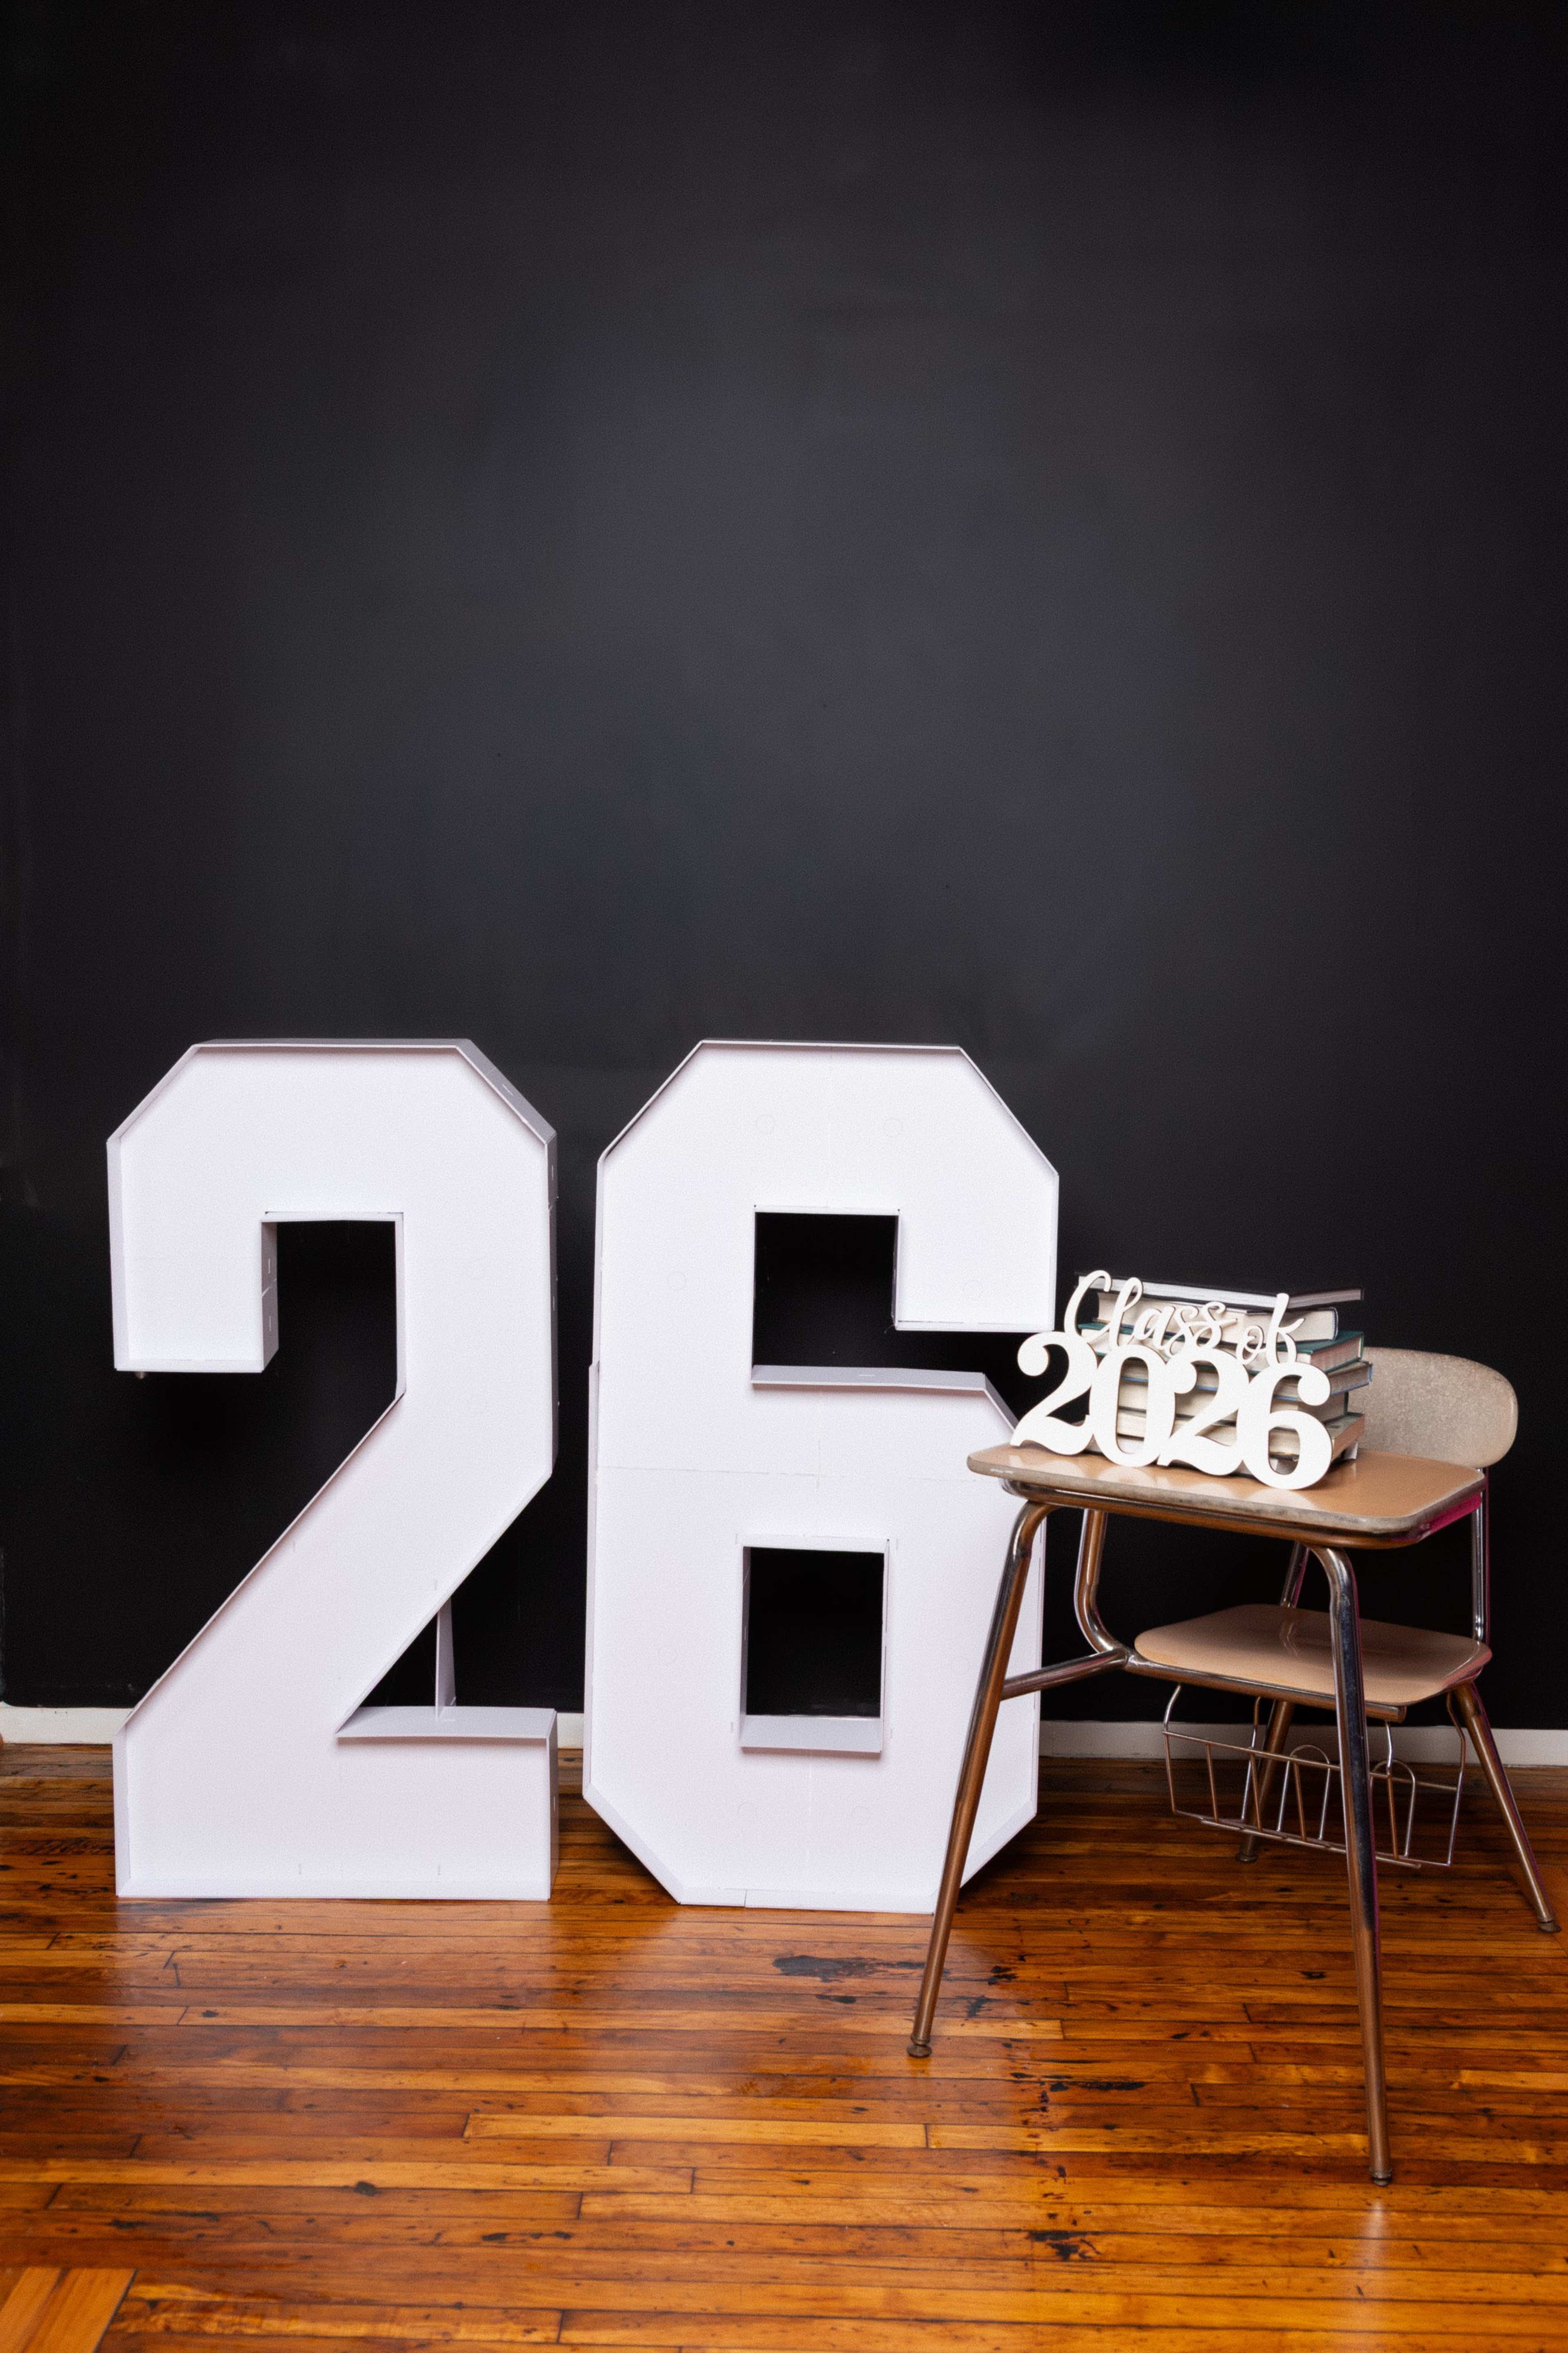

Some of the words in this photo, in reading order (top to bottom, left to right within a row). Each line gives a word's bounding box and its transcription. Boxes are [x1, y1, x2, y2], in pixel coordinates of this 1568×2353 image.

[1063, 1269, 1237, 1358] Class
[105, 1037, 1060, 1914] 26
[1010, 1330, 1333, 1491] 2026
